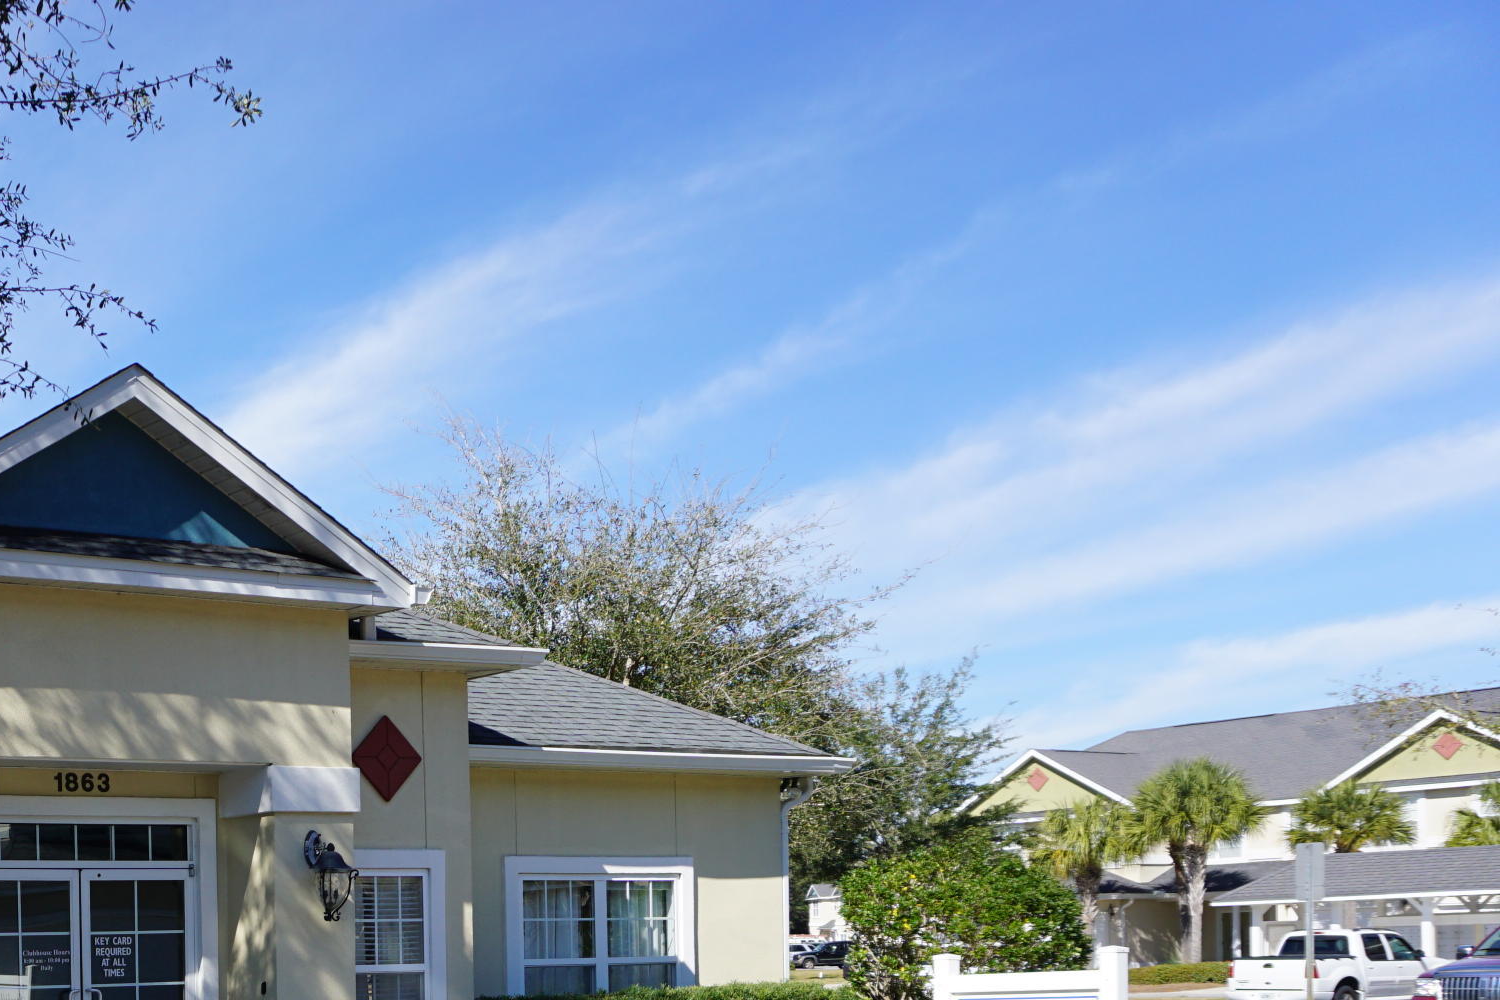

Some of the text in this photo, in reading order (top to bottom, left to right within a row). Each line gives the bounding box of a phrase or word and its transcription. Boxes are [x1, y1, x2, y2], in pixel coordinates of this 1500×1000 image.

[54, 772, 110, 792] 1863
[94, 936, 132, 945] KEY CARD
[95, 947, 132, 957] REQUIRED
[101, 957, 127, 967] AT ALL
[103, 968, 125, 977] TIMES
